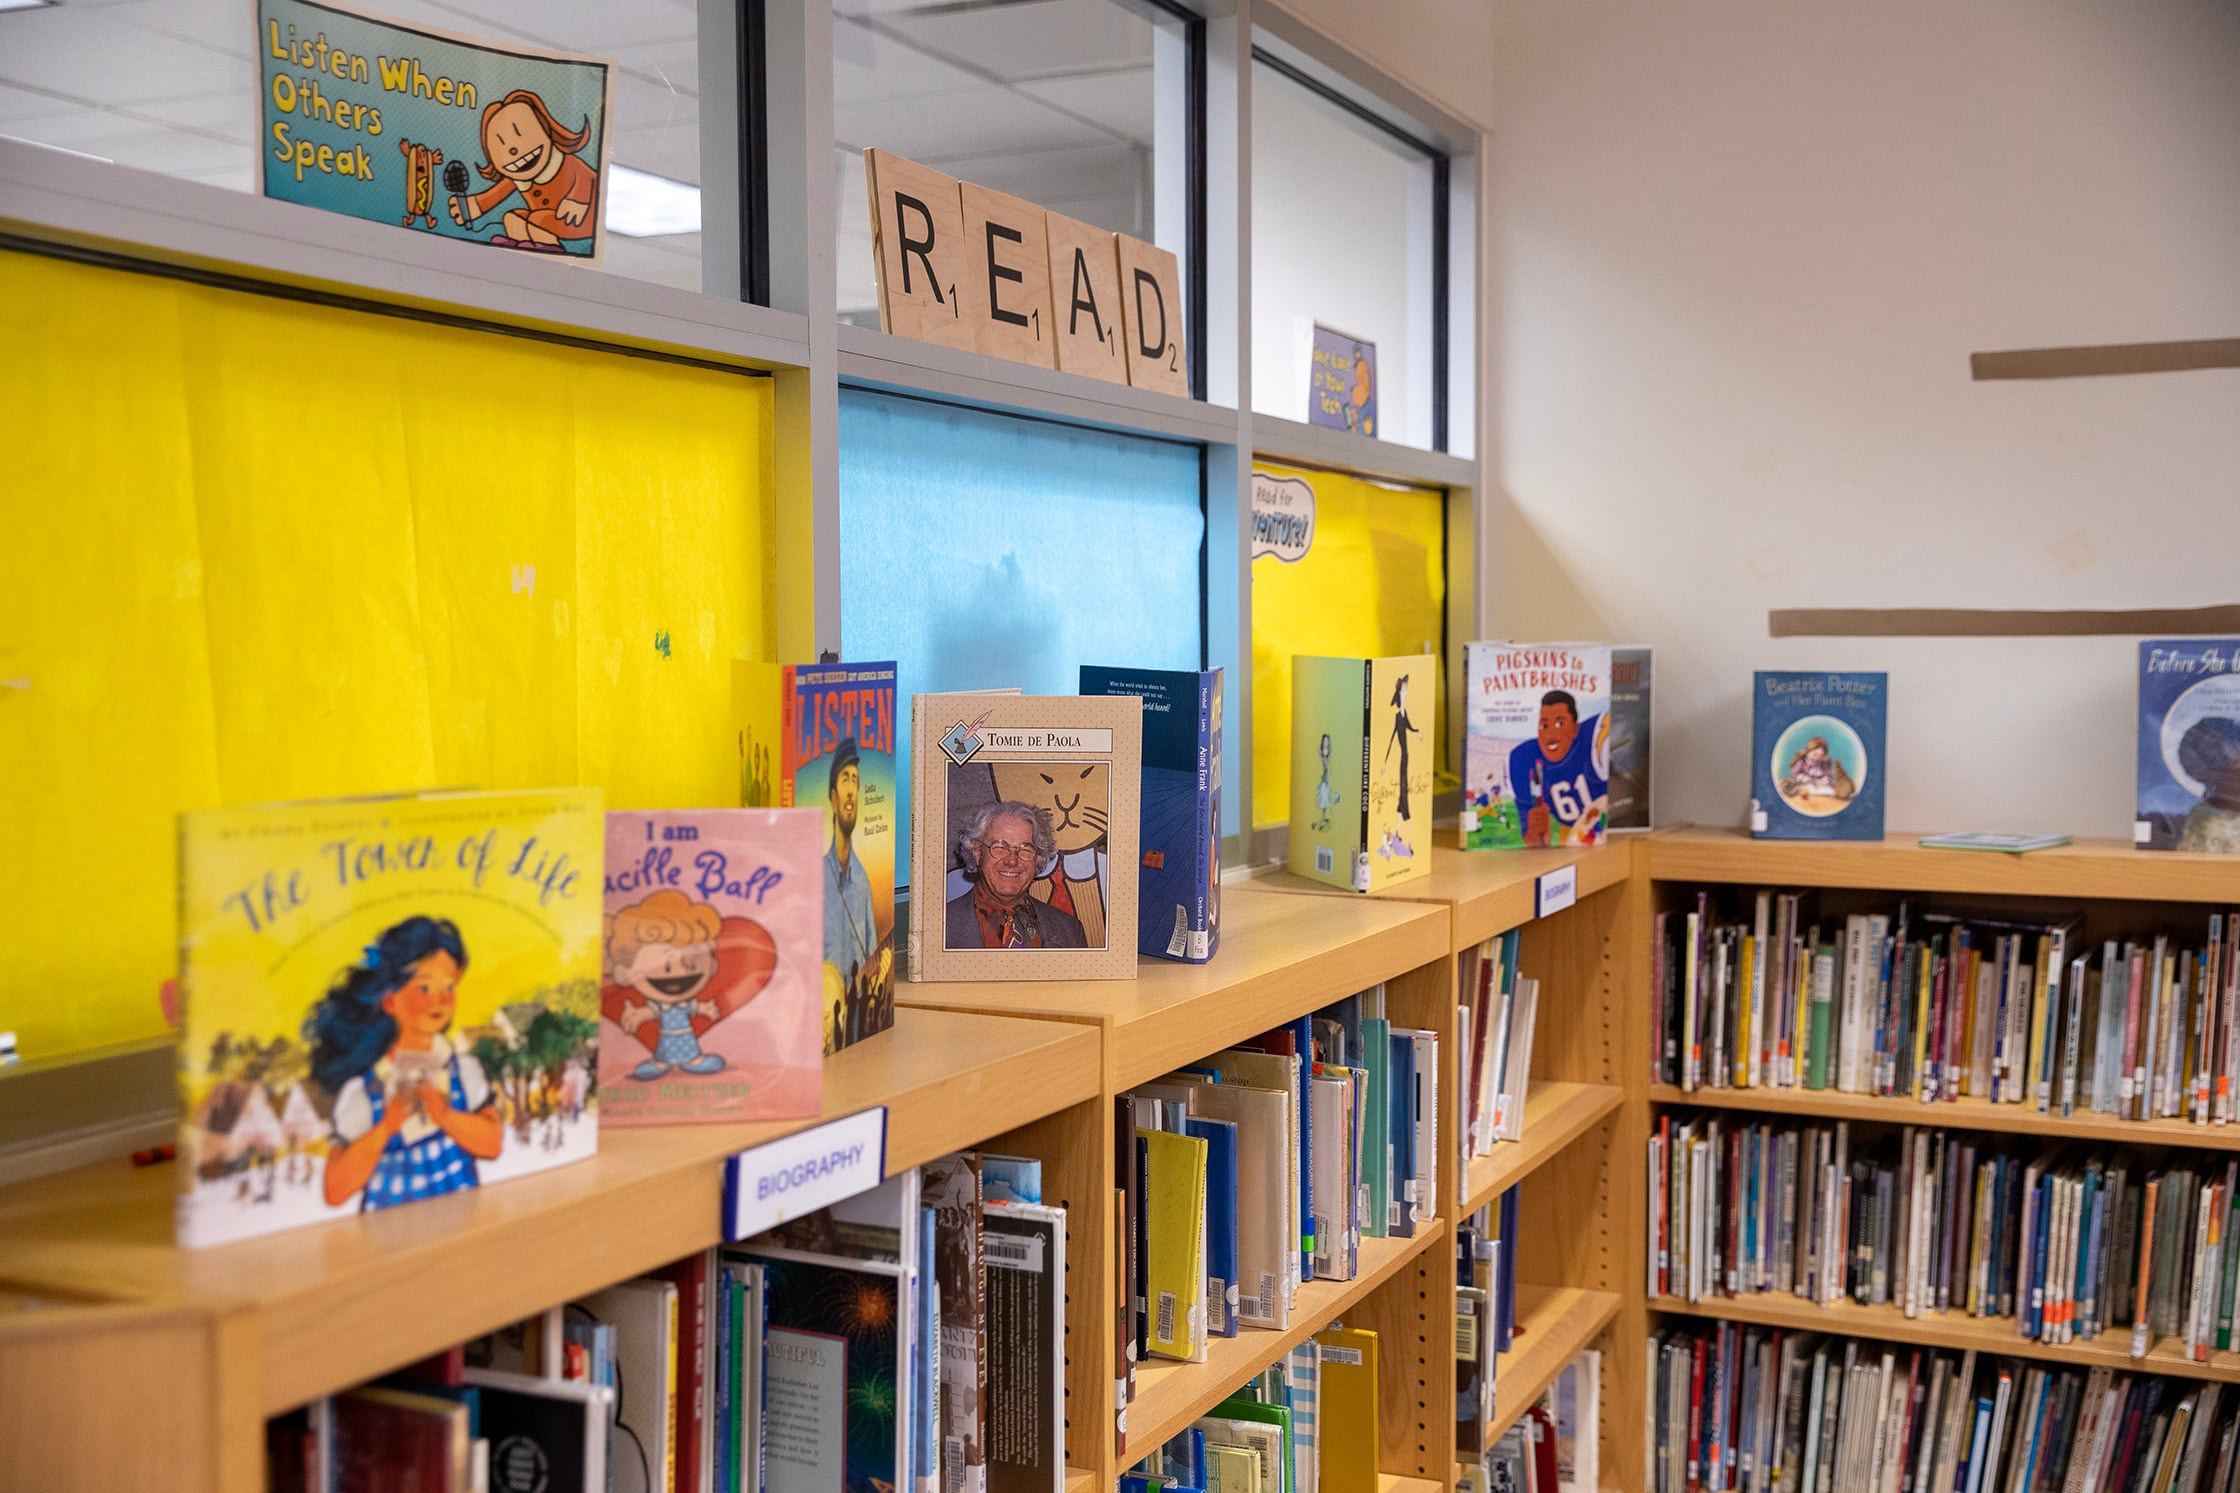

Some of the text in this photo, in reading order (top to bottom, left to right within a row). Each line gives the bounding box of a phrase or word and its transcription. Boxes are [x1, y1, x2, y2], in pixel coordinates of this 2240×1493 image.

[269, 19, 478, 110] Listen When
[271, 73, 383, 136] Others
[273, 121, 375, 182] Speak
[1496, 650, 1568, 672] PIGSKINS
[1483, 671, 1598, 695] PAINTBRUSHES
[1827, 675, 1876, 695] Potter
[795, 687, 893, 772] LISTEN
[987, 732, 1081, 747] TOMIE DE PAOLA
[1199, 746, 1208, 791] Anne Frank
[783, 779, 793, 808] LIST
[1549, 773, 1592, 822] 61
[646, 821, 699, 841] I am
[223, 828, 581, 933] The Tower of Life
[603, 847, 783, 905] ucille Ball
[1231, 1076, 1249, 1086] stop
[757, 1143, 865, 1201] BIOGRAPHY
[978, 1313, 985, 1335] MY
[767, 1343, 826, 1366] AUTIFUL
